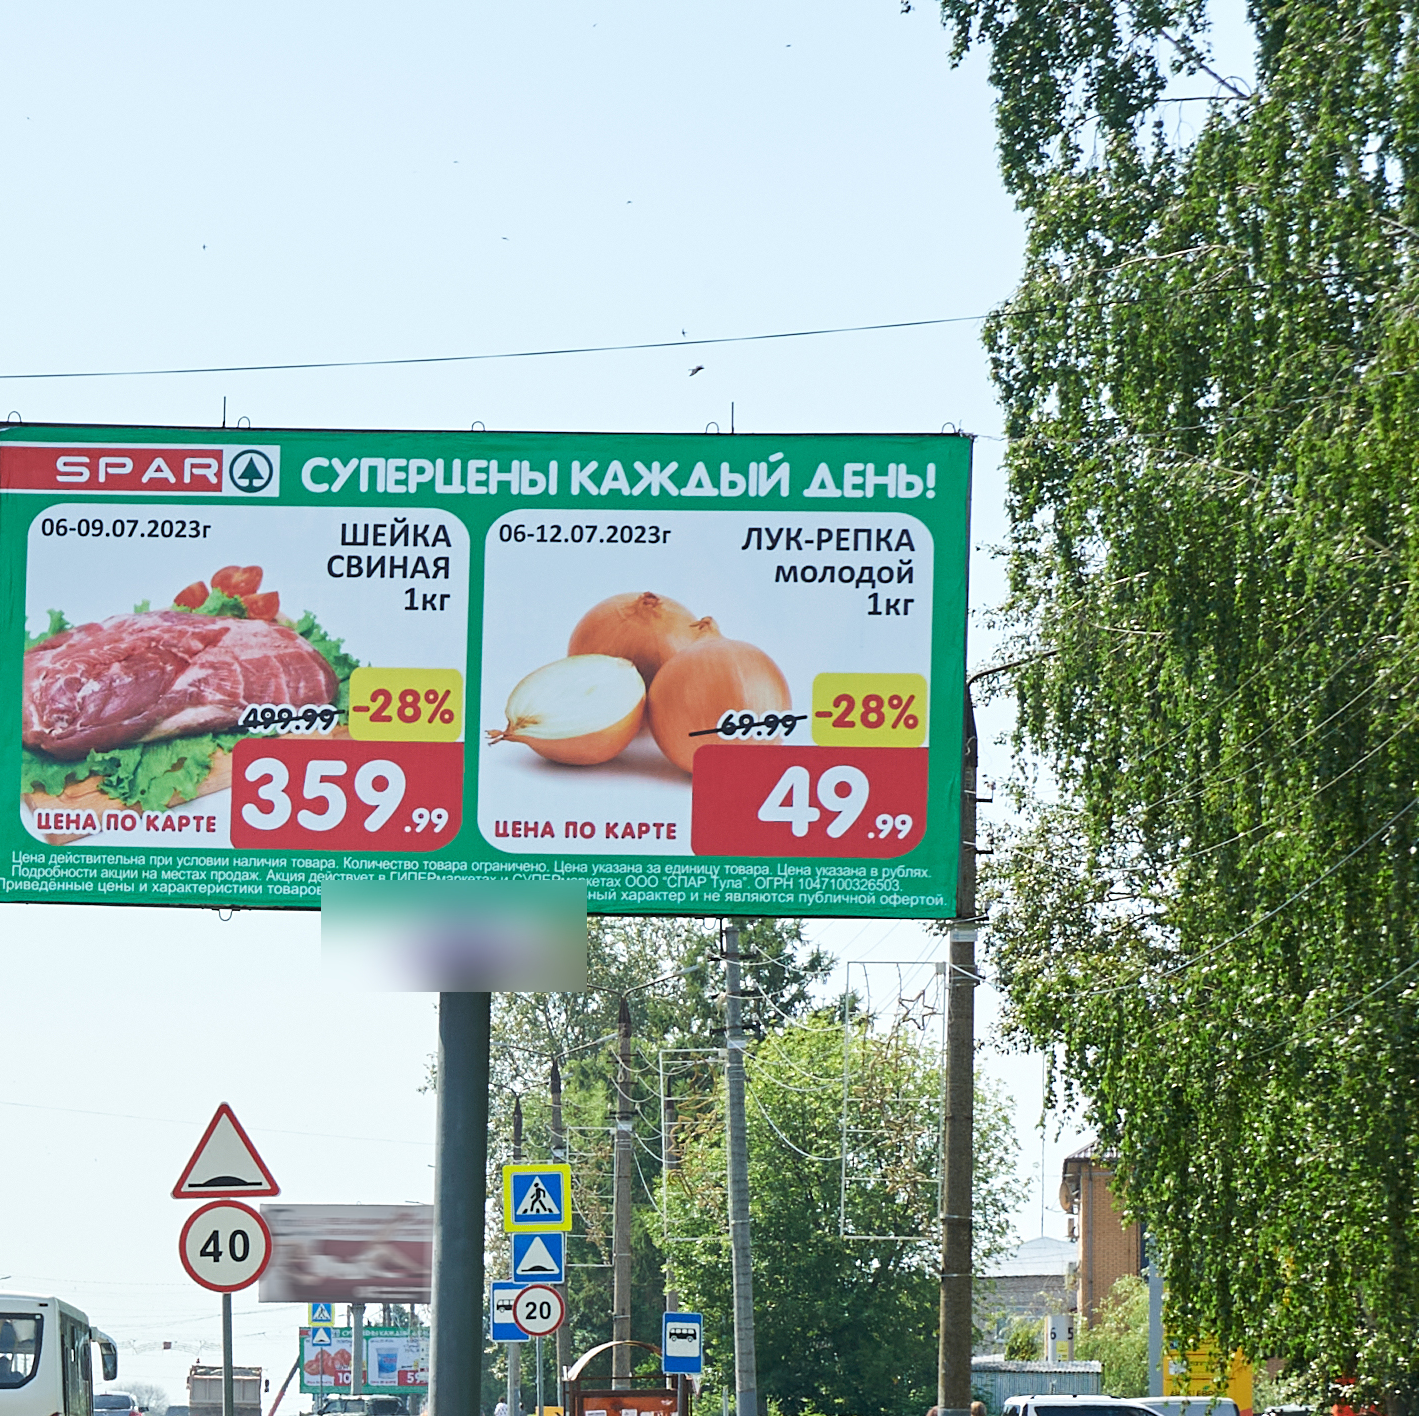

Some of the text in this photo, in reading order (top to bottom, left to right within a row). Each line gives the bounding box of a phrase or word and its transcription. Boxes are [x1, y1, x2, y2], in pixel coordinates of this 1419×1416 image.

[56, 456, 218, 484] SPAR
[301, 452, 936, 499] СУПЕРЦЕНЫ КАЖДЫЙ ДЕНЬ!
[41, 518, 211, 539] 06-09.07.2023г
[340, 517, 452, 547] ШЕЙКА
[499, 524, 671, 544] 06-12.07.2023г
[742, 527, 915, 552] ЛУК-РЕПКА
[327, 555, 450, 579] СВИНАЯ
[774, 559, 914, 589] молодой
[352, 687, 455, 725] -28%
[814, 693, 919, 730] -28%
[37, 812, 216, 833] ЦЕНА ПО КАРТЕ
[495, 820, 677, 840] ЦЕНА ПО КАРТЕ
[200, 1229, 250, 1262] 40
[525, 1301, 551, 1319] 20
